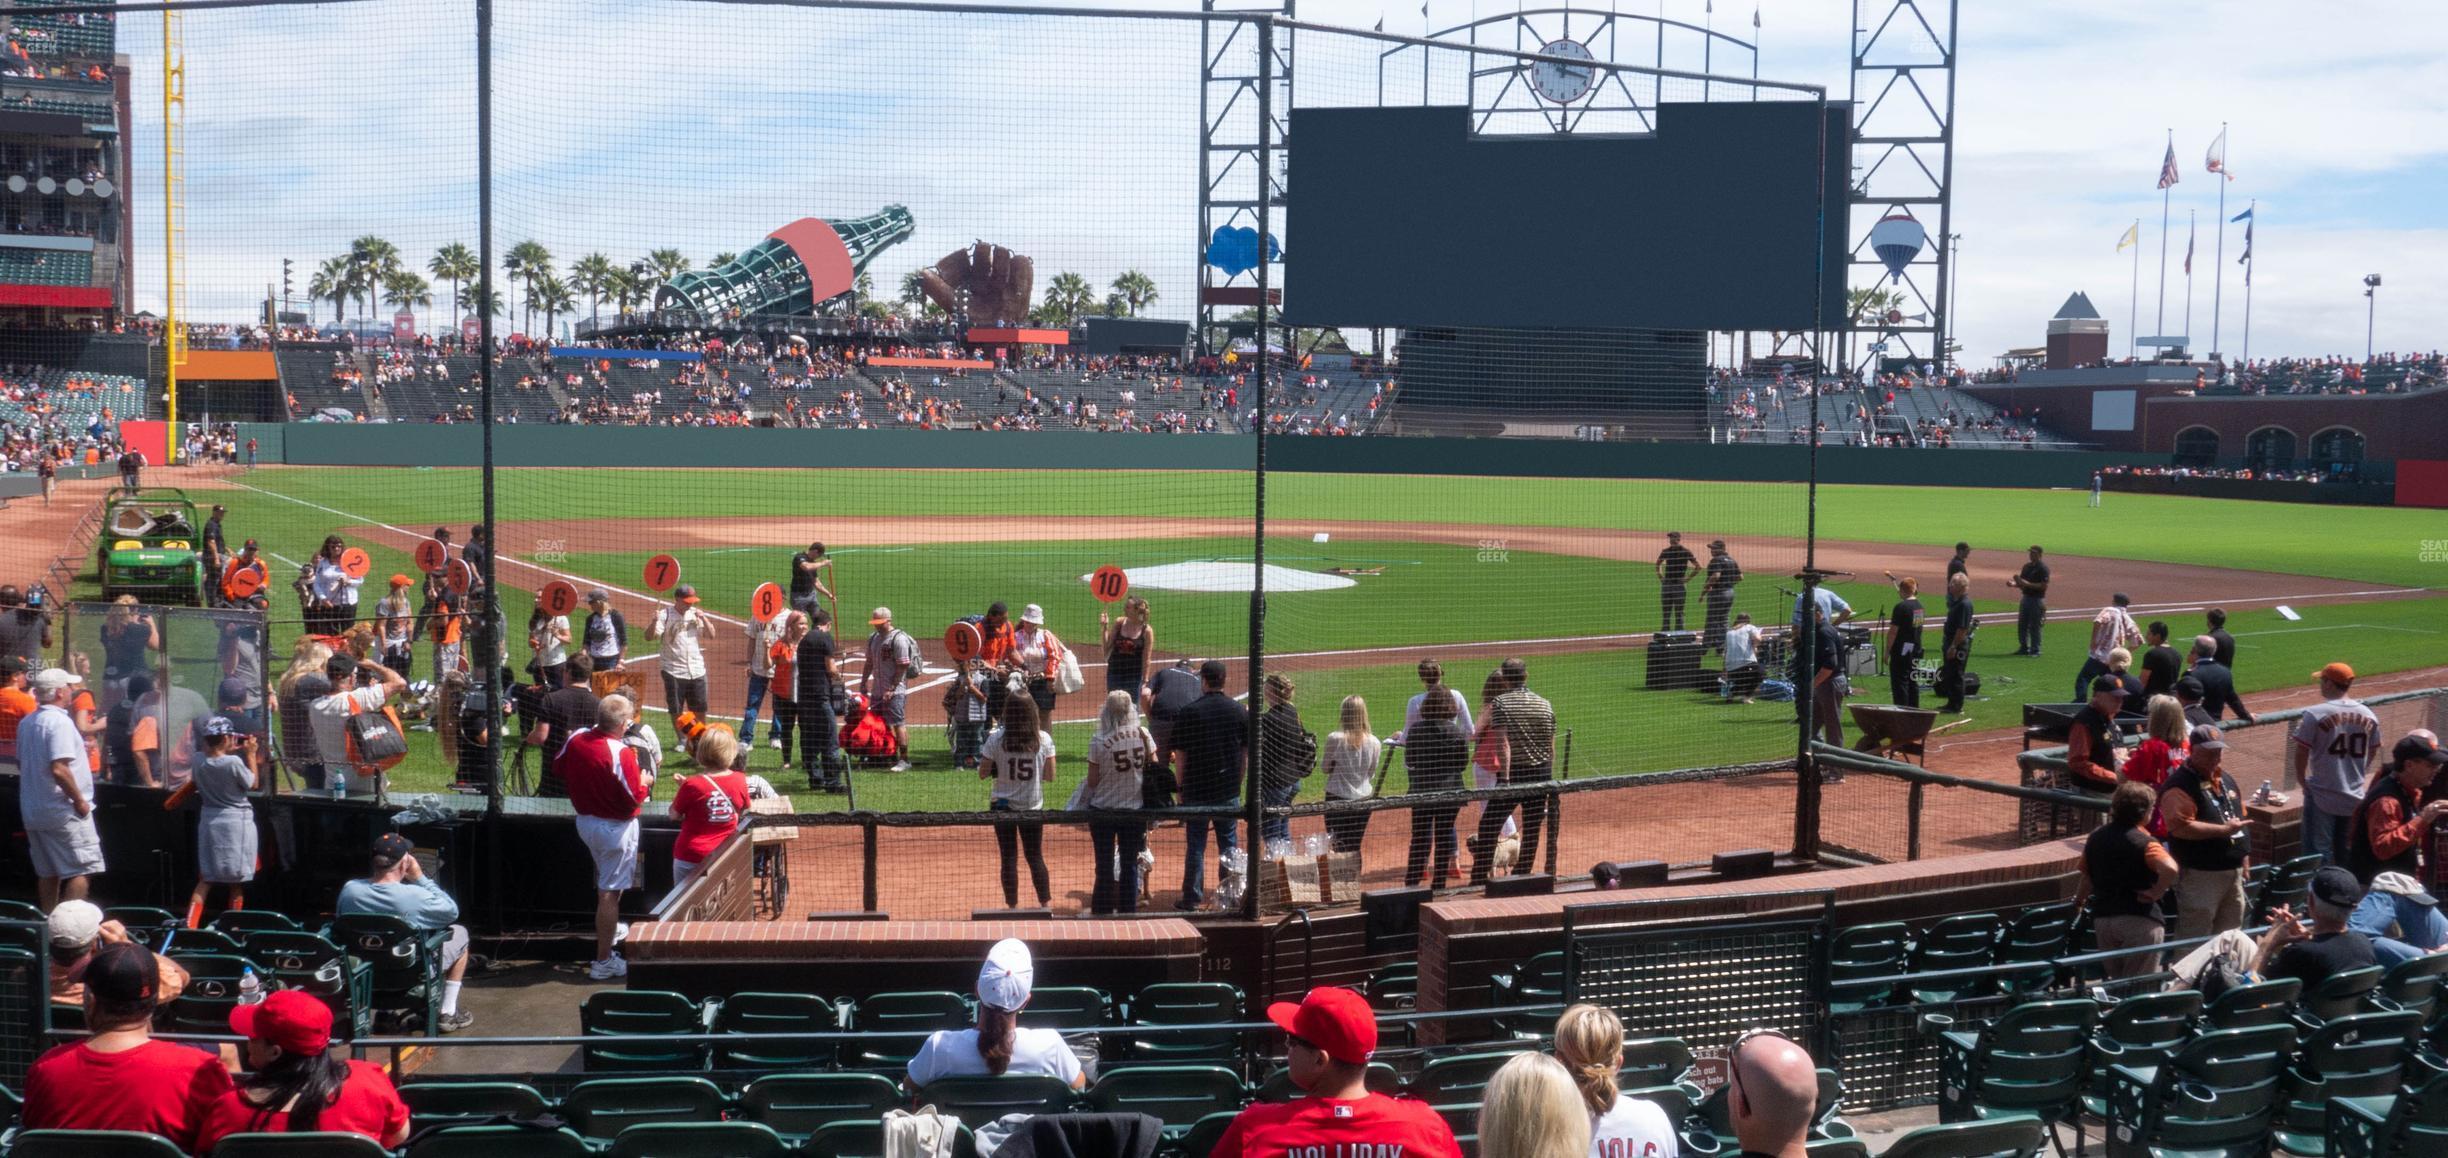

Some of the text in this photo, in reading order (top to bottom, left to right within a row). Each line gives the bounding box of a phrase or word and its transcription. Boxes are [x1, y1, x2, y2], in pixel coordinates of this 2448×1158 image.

[347, 555, 363, 572] 2
[425, 545, 434, 566] 4
[655, 562, 669, 585] 7
[1099, 571, 1122, 597] 10
[551, 587, 566, 611] 6
[762, 591, 772, 615] 8
[955, 629, 969, 654] 9
[2327, 732, 2367, 759] 40
[1008, 757, 1034, 781] 15
[1113, 746, 1146, 773] 55
[1208, 957, 1232, 971] 112
[1703, 1066, 1716, 1075] out
[1707, 1076, 1724, 1085] bats
